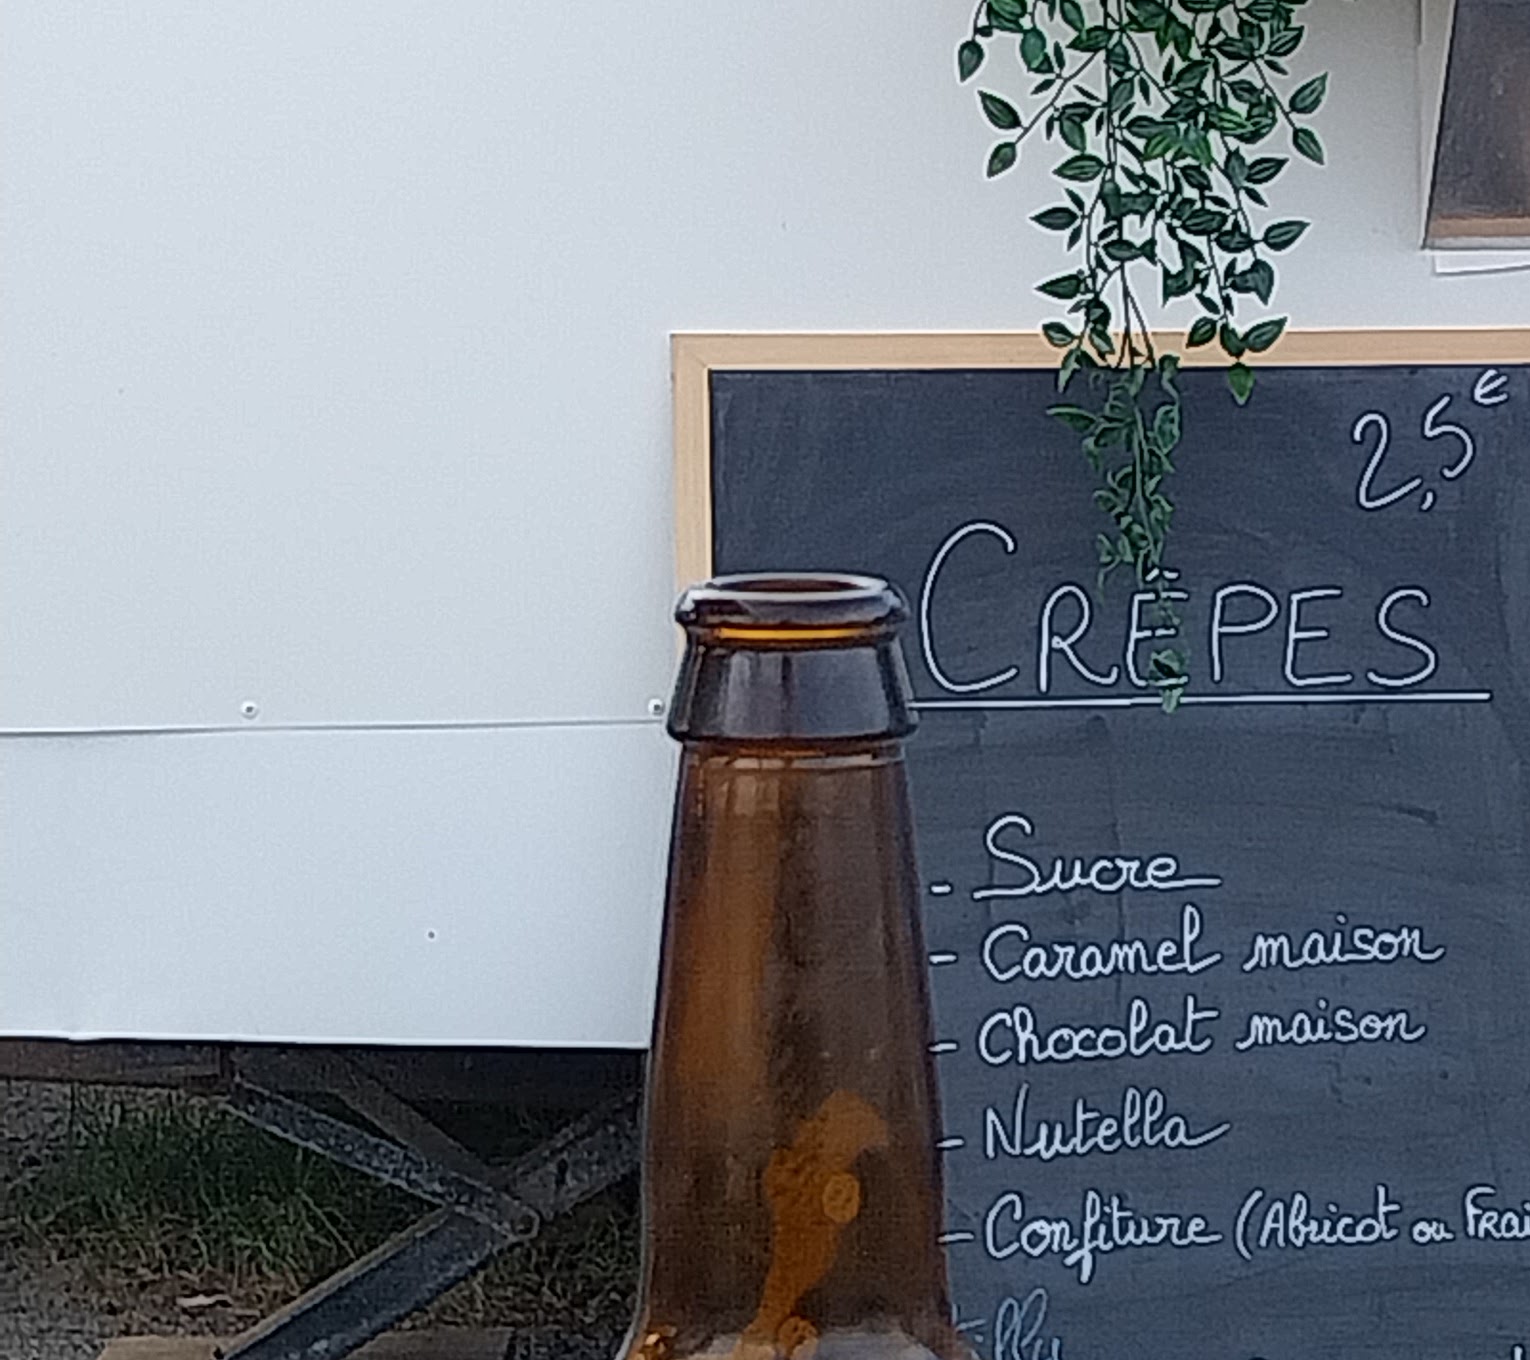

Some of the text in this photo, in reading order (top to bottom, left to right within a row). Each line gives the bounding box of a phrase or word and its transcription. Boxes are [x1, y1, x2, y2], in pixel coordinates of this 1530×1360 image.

[972, 816, 1222, 900] Sucre
[981, 904, 1447, 982] Caramel maison
[978, 995, 1427, 1066] Chocolat maison
[984, 1082, 1232, 1160] Nutella
[984, 1189, 1224, 1284] Confiture
[1234, 1184, 1402, 1260] (Abricot
[1411, 1216, 1456, 1242] ou
